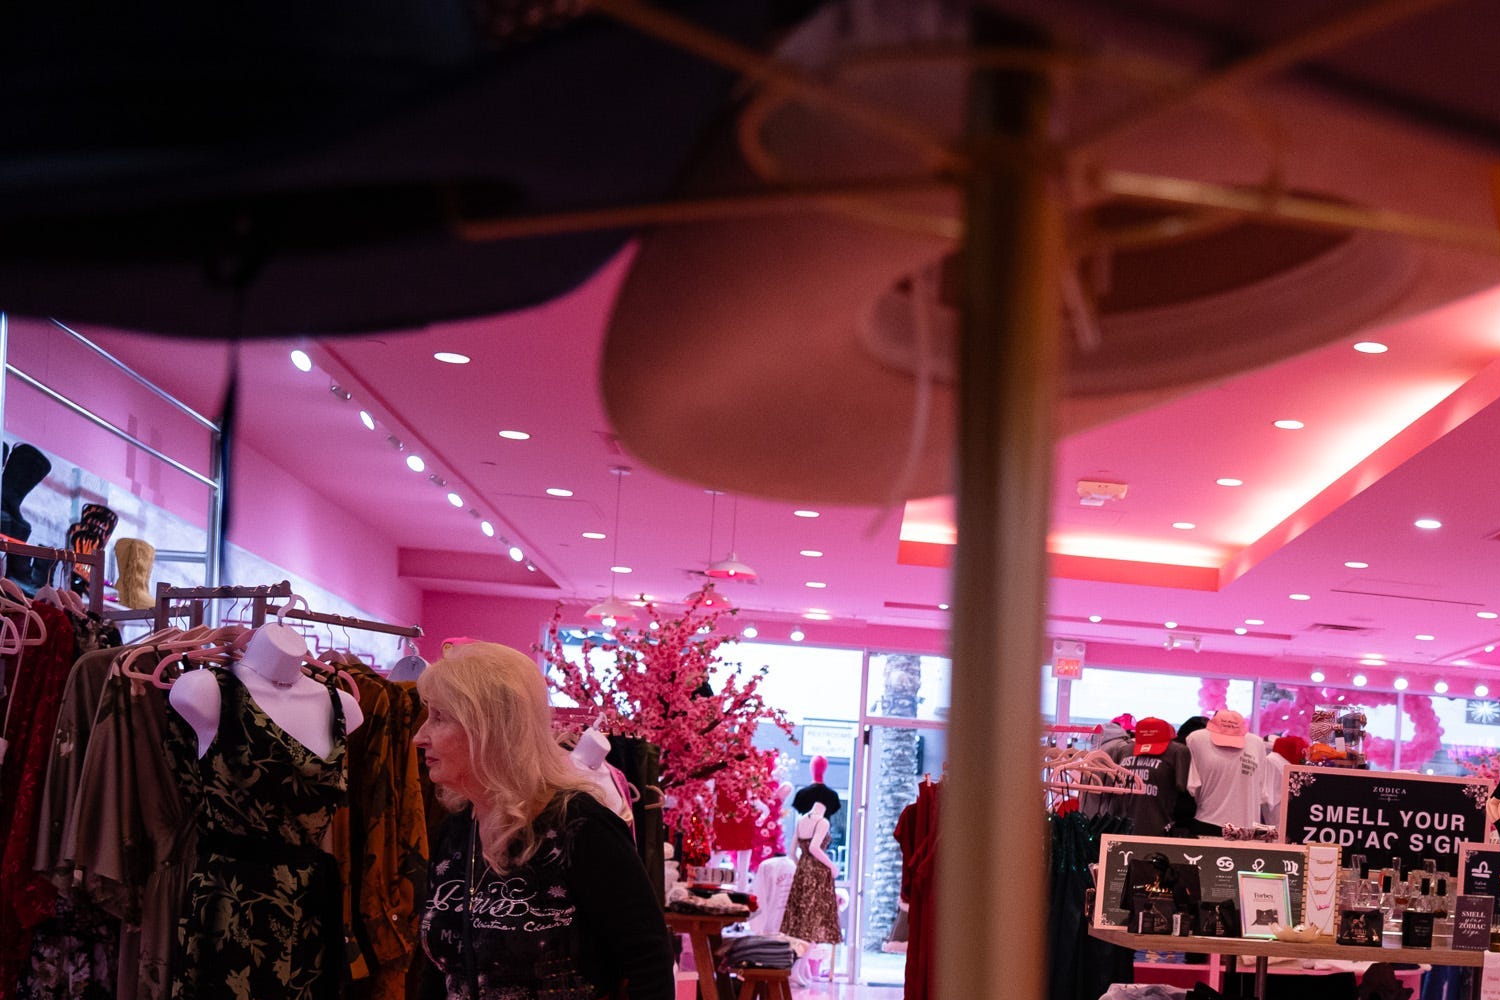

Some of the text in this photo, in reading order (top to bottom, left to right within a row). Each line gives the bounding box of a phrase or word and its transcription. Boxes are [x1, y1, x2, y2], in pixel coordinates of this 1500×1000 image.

[1121, 755, 1161, 769] UST WANT
[1373, 785, 1407, 795] ZODICA
[1309, 804, 1465, 832] SMELL YOUR
[1254, 892, 1274, 900] Forbes
[1458, 922, 1486, 930] ZODIAC
